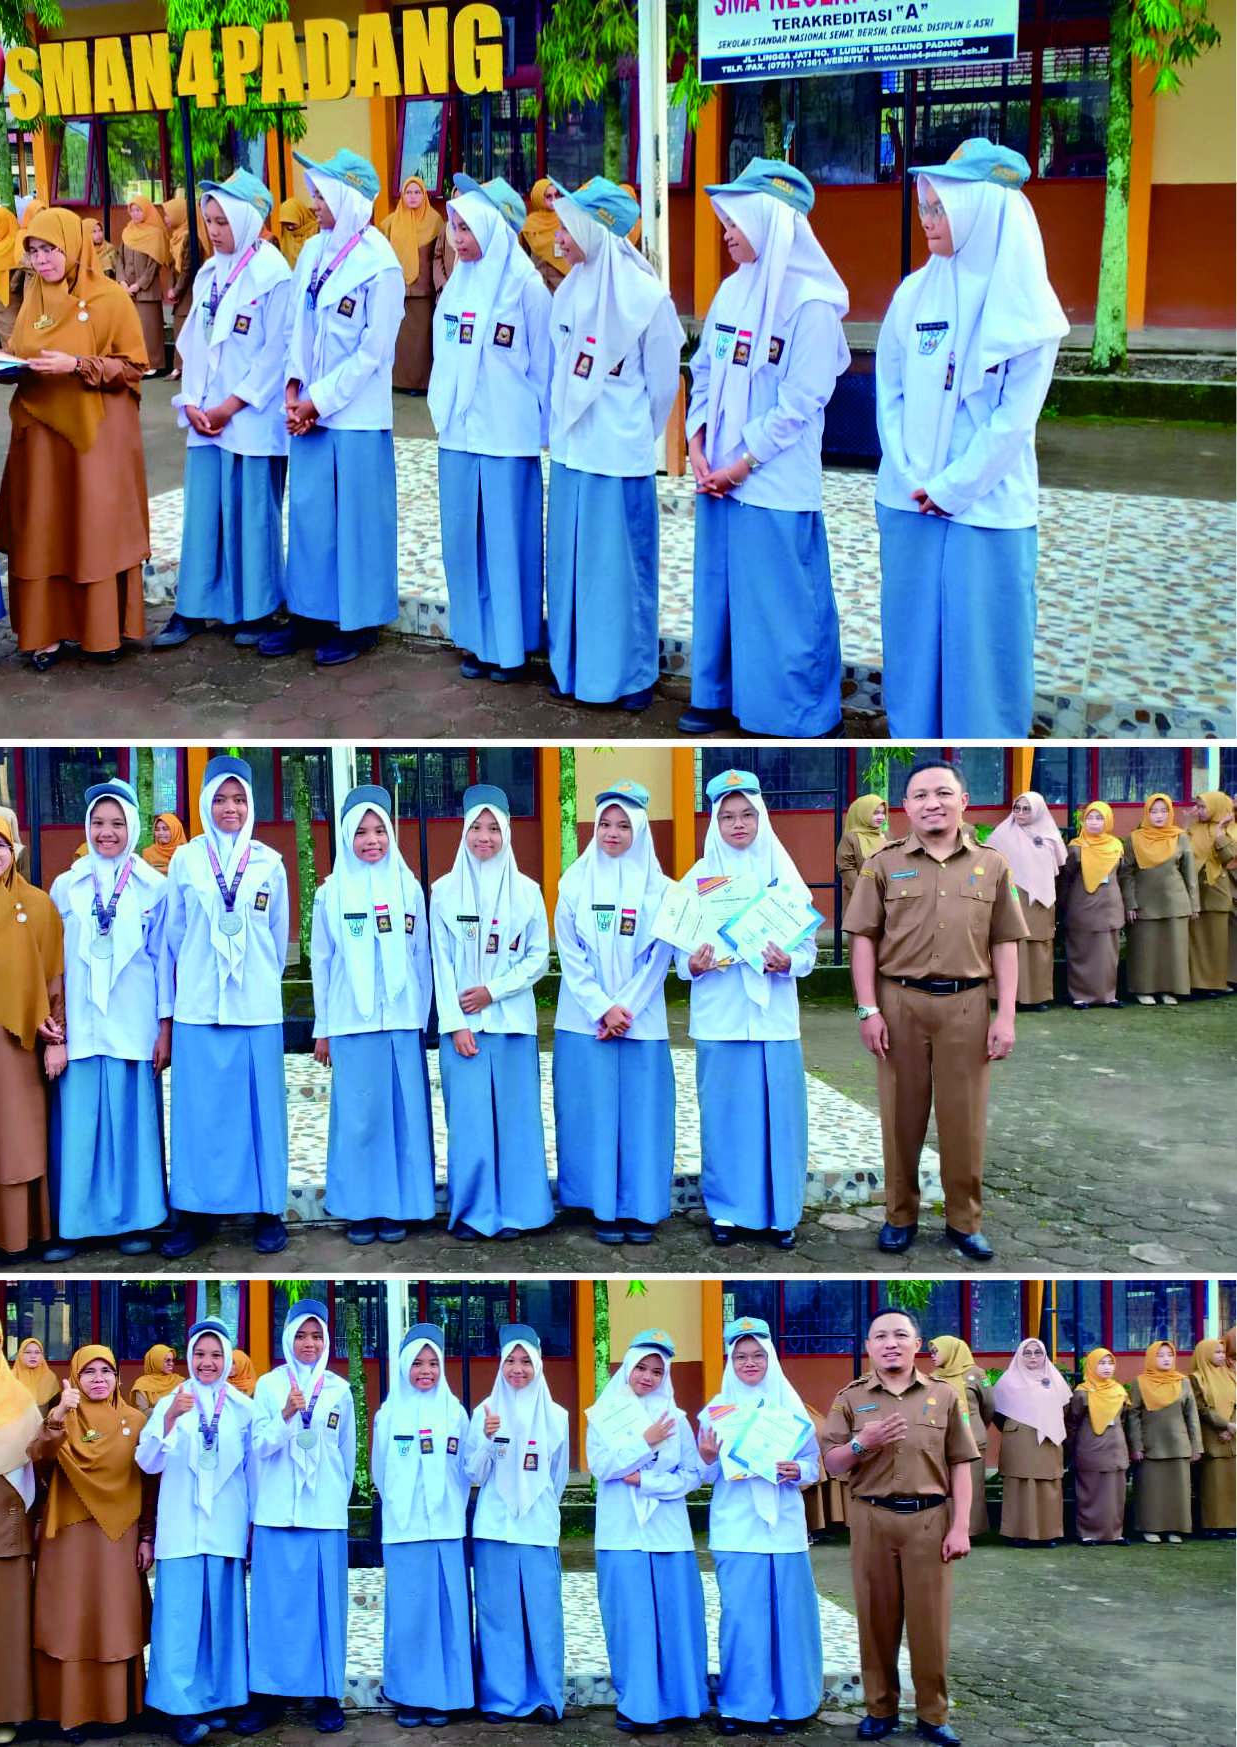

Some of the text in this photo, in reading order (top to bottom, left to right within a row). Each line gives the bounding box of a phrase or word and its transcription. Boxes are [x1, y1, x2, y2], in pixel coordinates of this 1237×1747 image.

[772, 9, 892, 30] TERAKREDITASI
[717, 38, 751, 49] SEKOLAH
[752, 35, 788, 46] STANDAR
[788, 31, 827, 42] NASIONAL
[927, 20, 964, 32] DISIPLIN
[973, 18, 994, 28] ASRI
[757, 53, 791, 62] LINGGA
[792, 51, 812, 59] JATI
[839, 46, 870, 55] LUBUK
[872, 42, 923, 53] BEGALUNG
[925, 38, 964, 49] PADANG
[824, 55, 864, 65] WEBSITE
